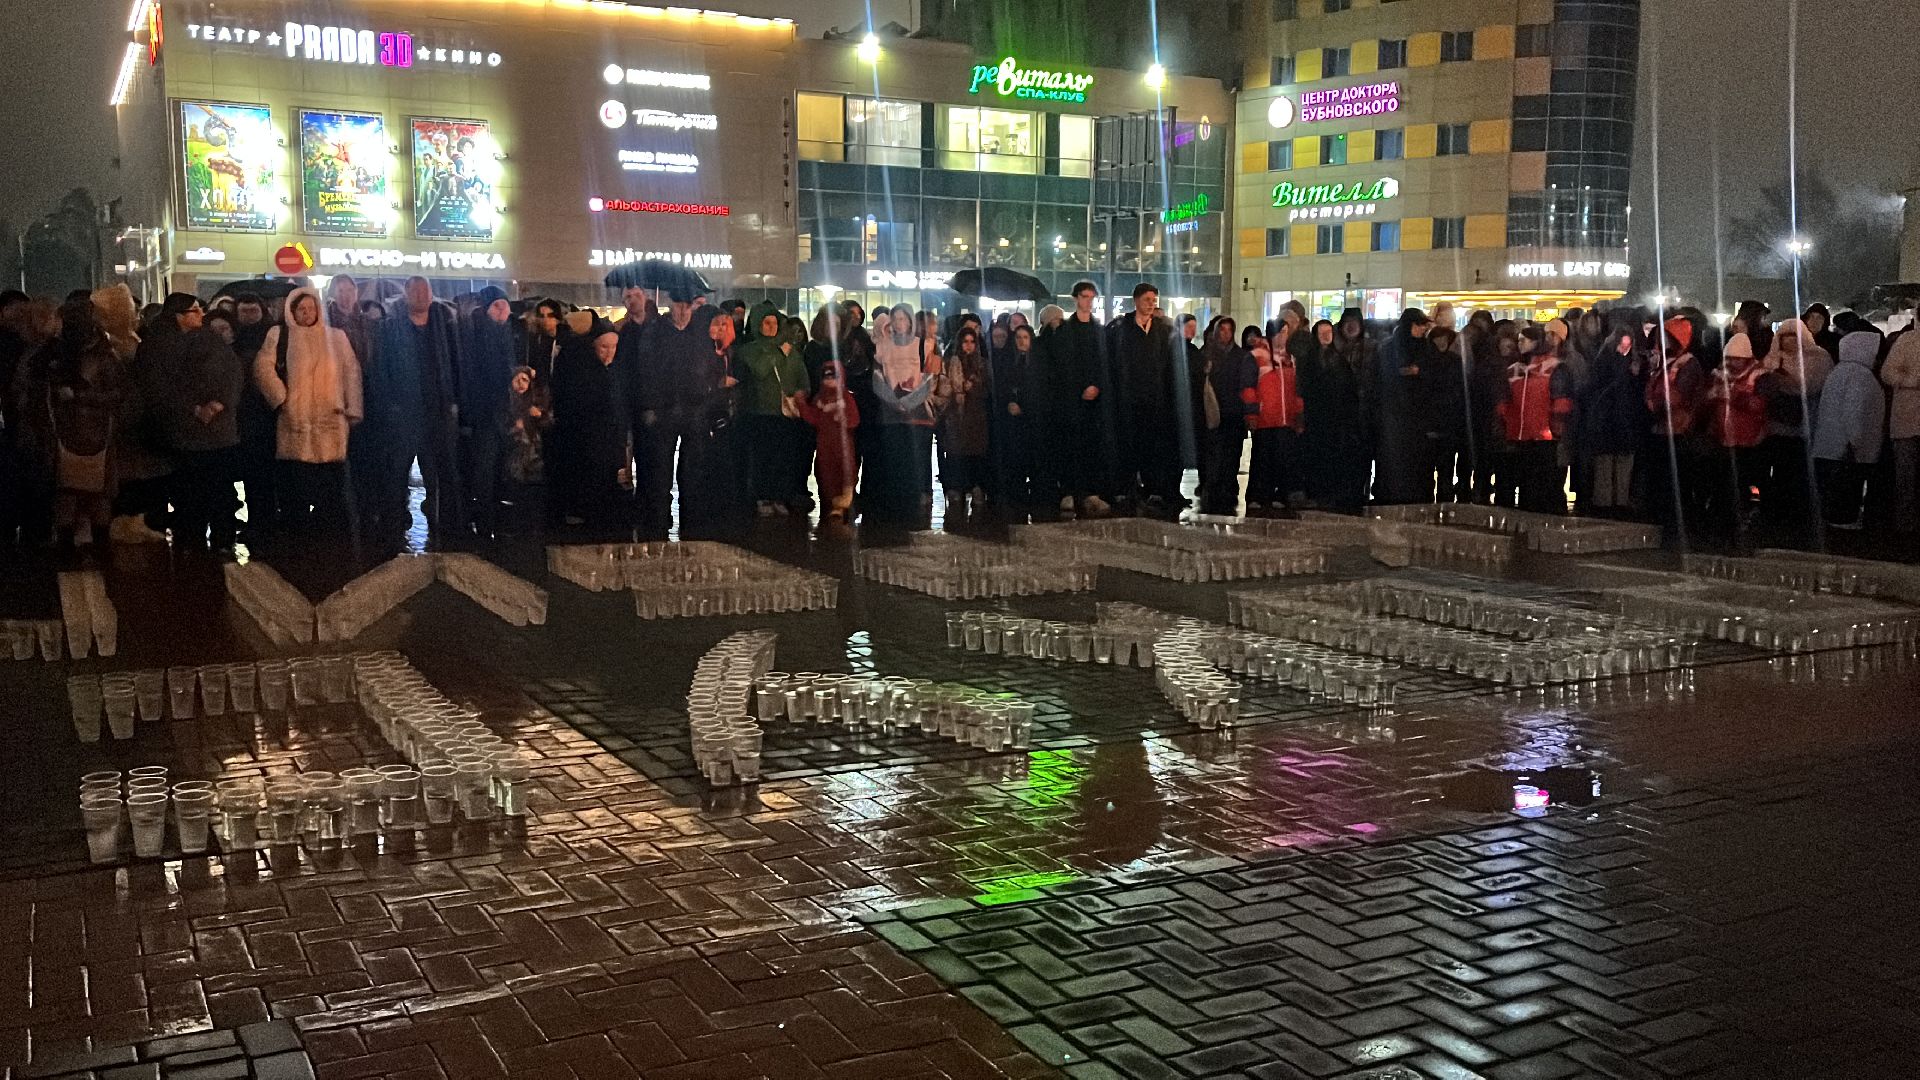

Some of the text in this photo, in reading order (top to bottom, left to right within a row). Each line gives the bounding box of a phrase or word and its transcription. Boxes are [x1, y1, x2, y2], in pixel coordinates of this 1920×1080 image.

[187, 21, 501, 68] ТЕАТР PRADA 3D КИНО
[1016, 87, 1085, 103] СПА-КЛУБ
[1301, 81, 1398, 106] ЦЕНТР ДОКТОРА
[1301, 97, 1398, 122] БУБНОВСКОГО
[606, 200, 730, 216] АЛЬФАСТРАХОВАНИЕ
[438, 251, 506, 269] ТОЧКА
[605, 247, 643, 266] ВАЙТ
[684, 253, 733, 269] ЛАУНЖ
[866, 269, 917, 289] DNS
[1508, 263, 1558, 278] HOTEL
[1563, 261, 1601, 277] EAST
